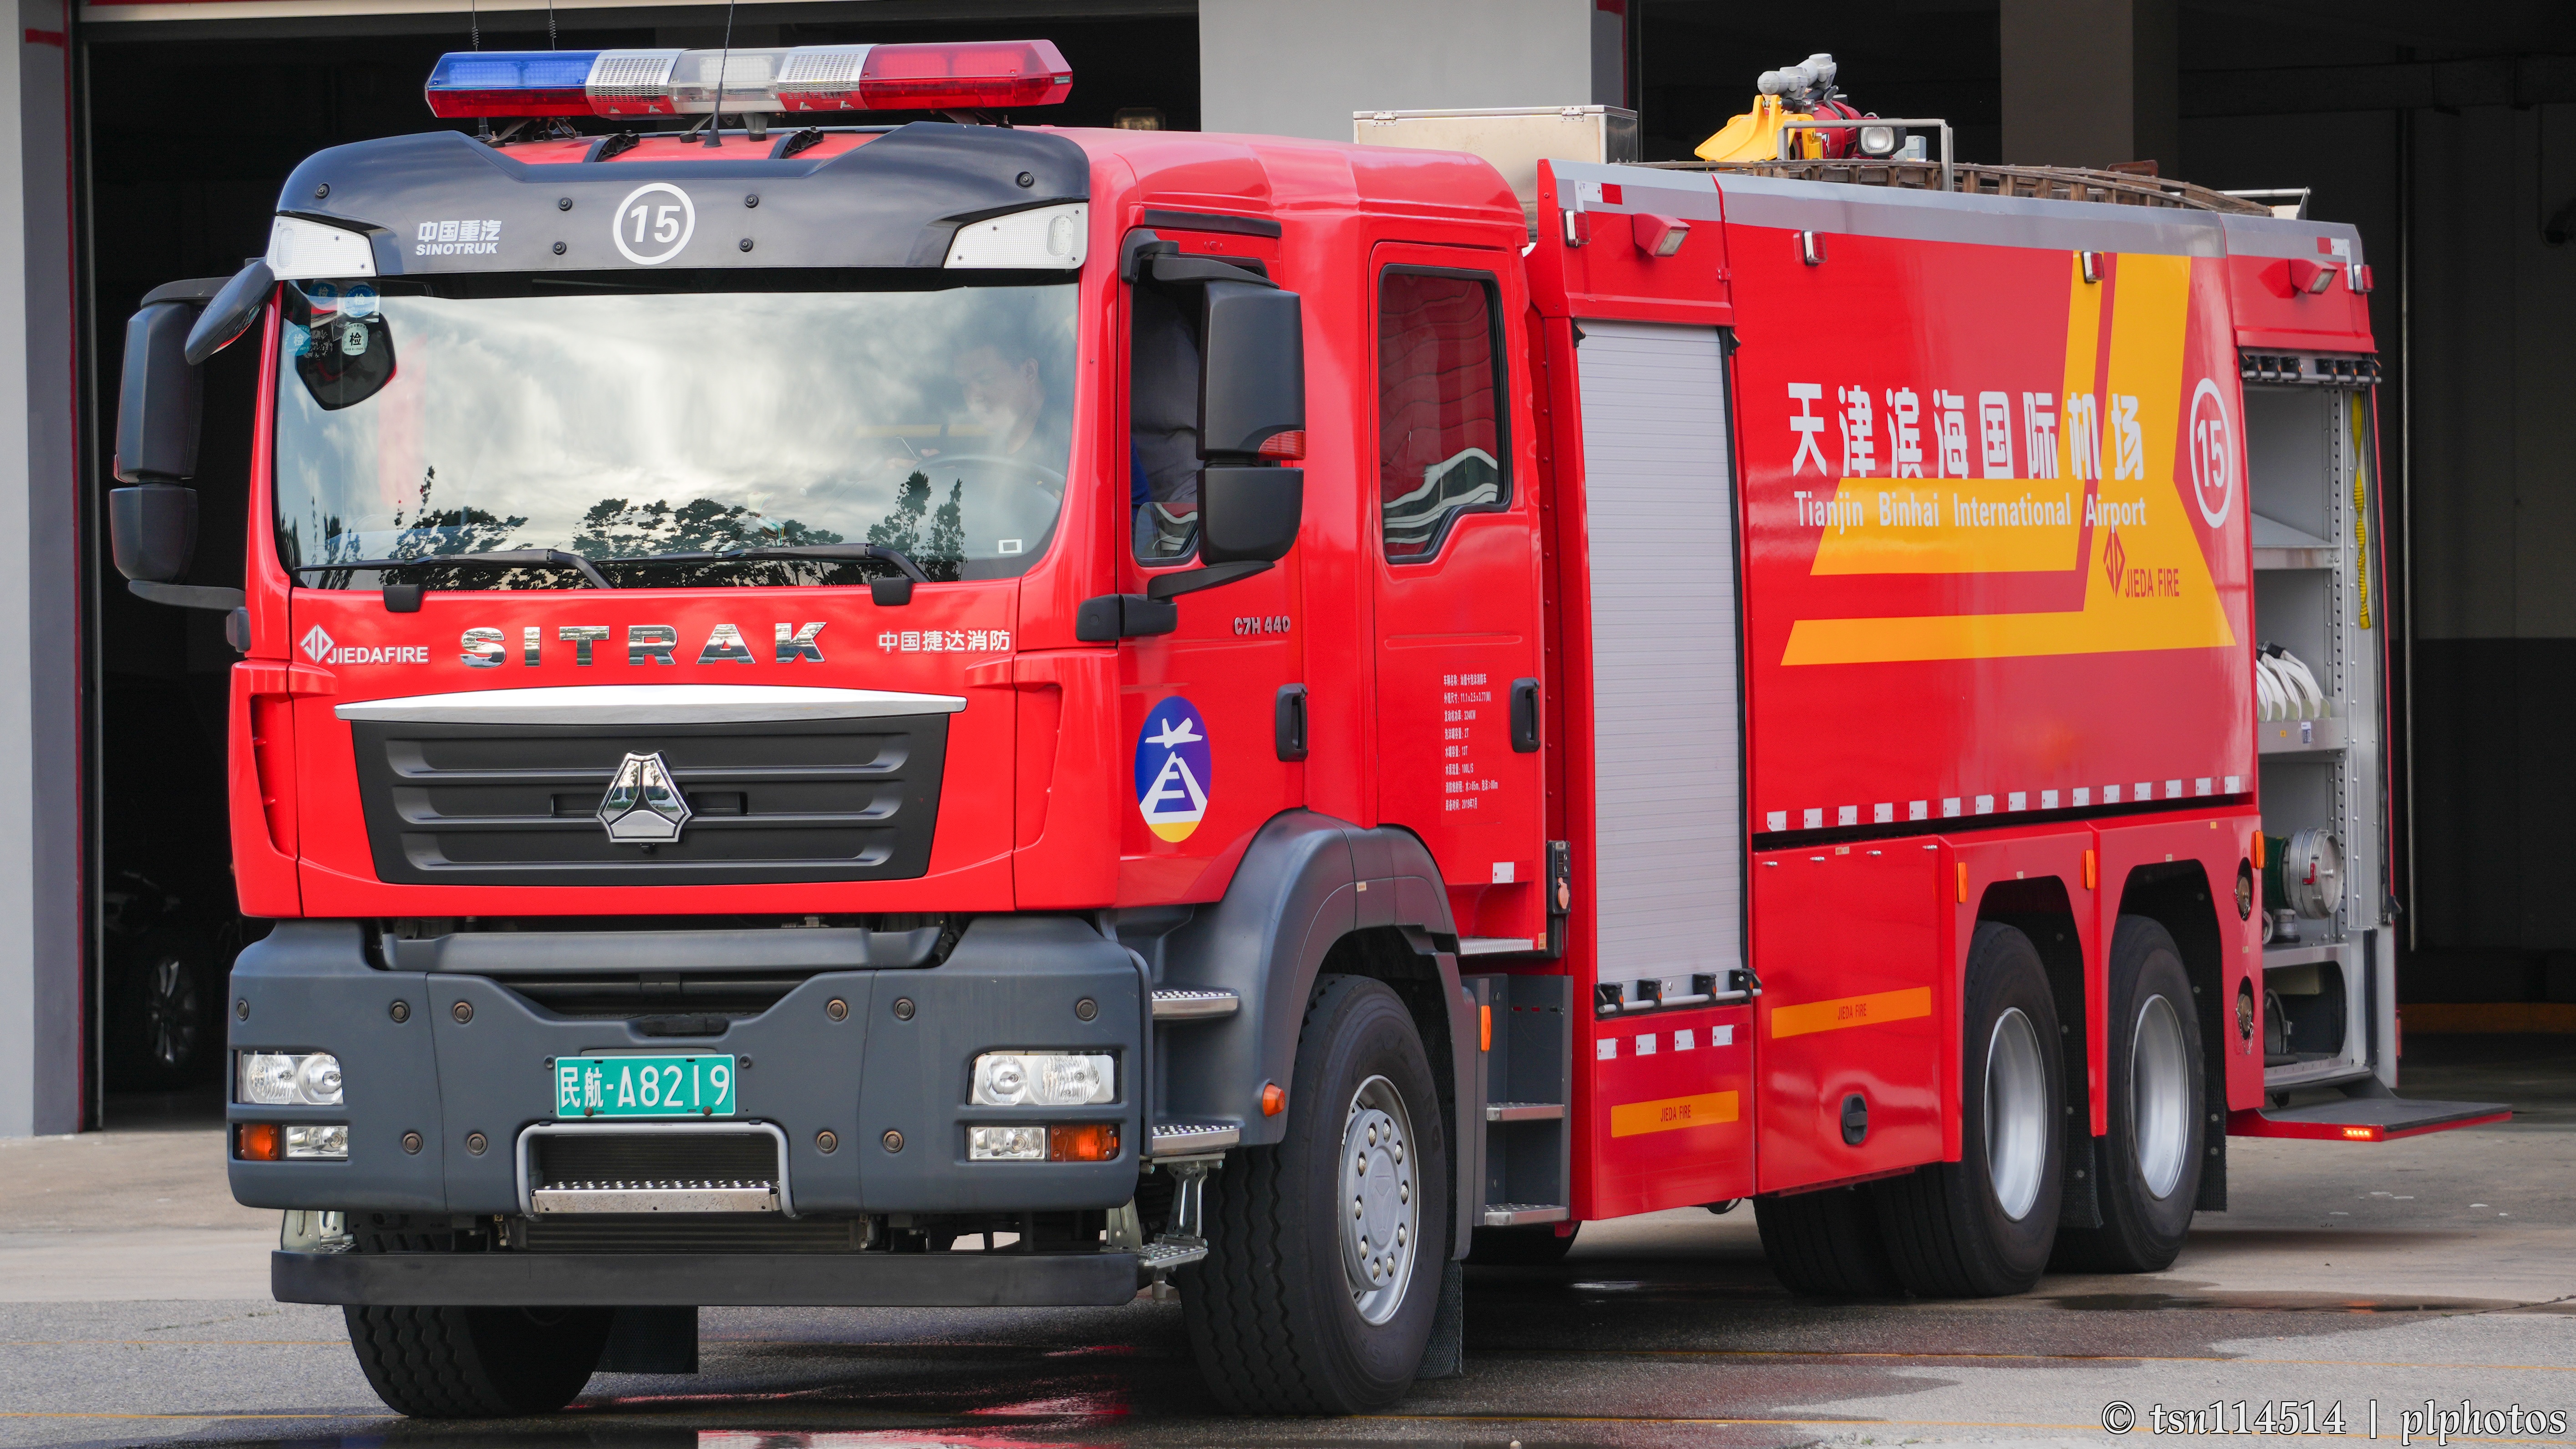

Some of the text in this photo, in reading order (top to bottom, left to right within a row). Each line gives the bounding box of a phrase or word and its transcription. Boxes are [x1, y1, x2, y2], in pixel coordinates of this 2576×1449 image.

[418, 219, 502, 242] 中国重汽
[630, 205, 681, 243] 15
[416, 242, 498, 256] SINOTRUK
[294, 333, 305, 346] 检
[350, 332, 362, 346] 检
[1788, 382, 2144, 481] 天津滨海国际机场
[2197, 419, 2225, 488] 15
[1794, 491, 2146, 535] Tianjin Binhai International Airport
[2125, 568, 2180, 598] JIEDA FIRE
[1235, 615, 1291, 635] C7H 440
[460, 622, 827, 668] SITRAK
[879, 629, 1011, 652] 中国捷达消防
[327, 646, 429, 664] JIEDAFIRE
[1837, 1002, 1867, 1021] JIEDA FIRE
[560, 1064, 730, 1108] 民航-A8219
[1660, 1103, 1692, 1123] JIEDA FIRE
